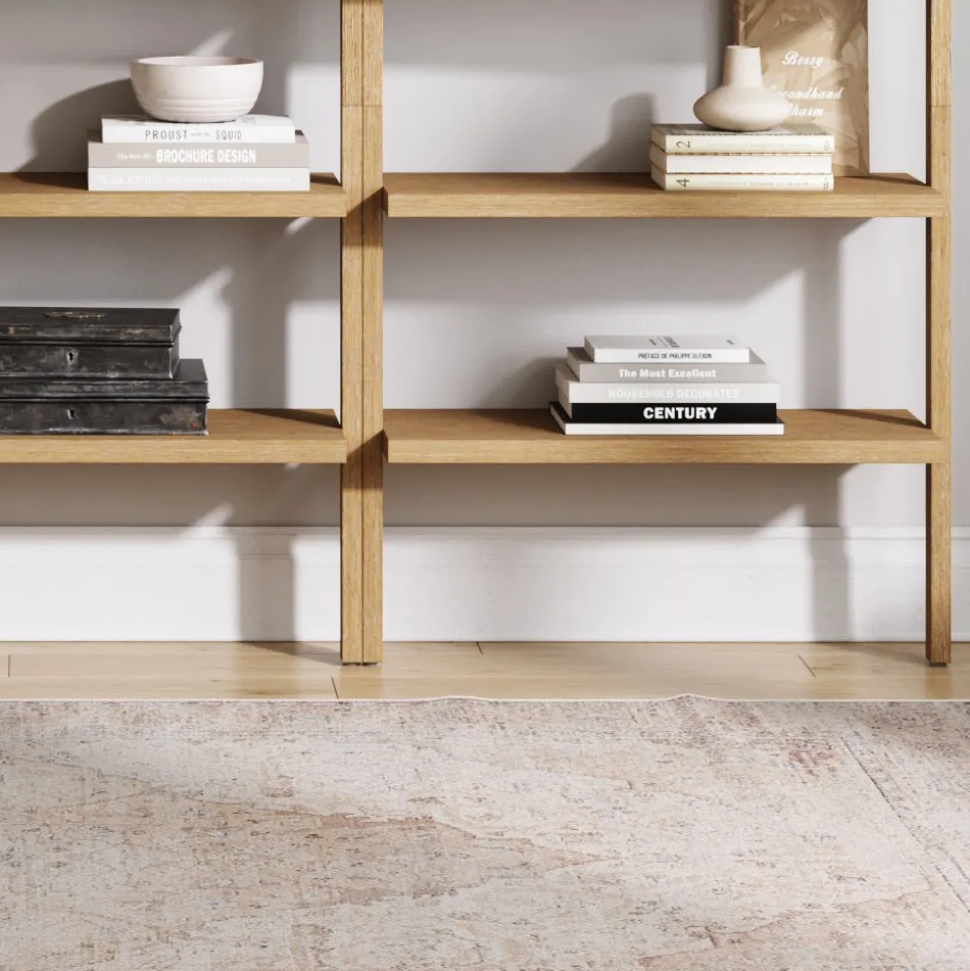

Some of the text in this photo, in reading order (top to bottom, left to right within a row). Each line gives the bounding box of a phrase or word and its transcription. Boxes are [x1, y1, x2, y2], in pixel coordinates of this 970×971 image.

[145, 129, 188, 140] PROUST
[215, 129, 242, 140] SQUID
[676, 139, 690, 149] 2
[156, 149, 256, 163] BROCHURE DESIGN
[676, 178, 690, 187] 4
[618, 369, 717, 378] The Most Excellent
[608, 388, 674, 399] HOUSEHOLD
[643, 407, 717, 420] CENTURY
